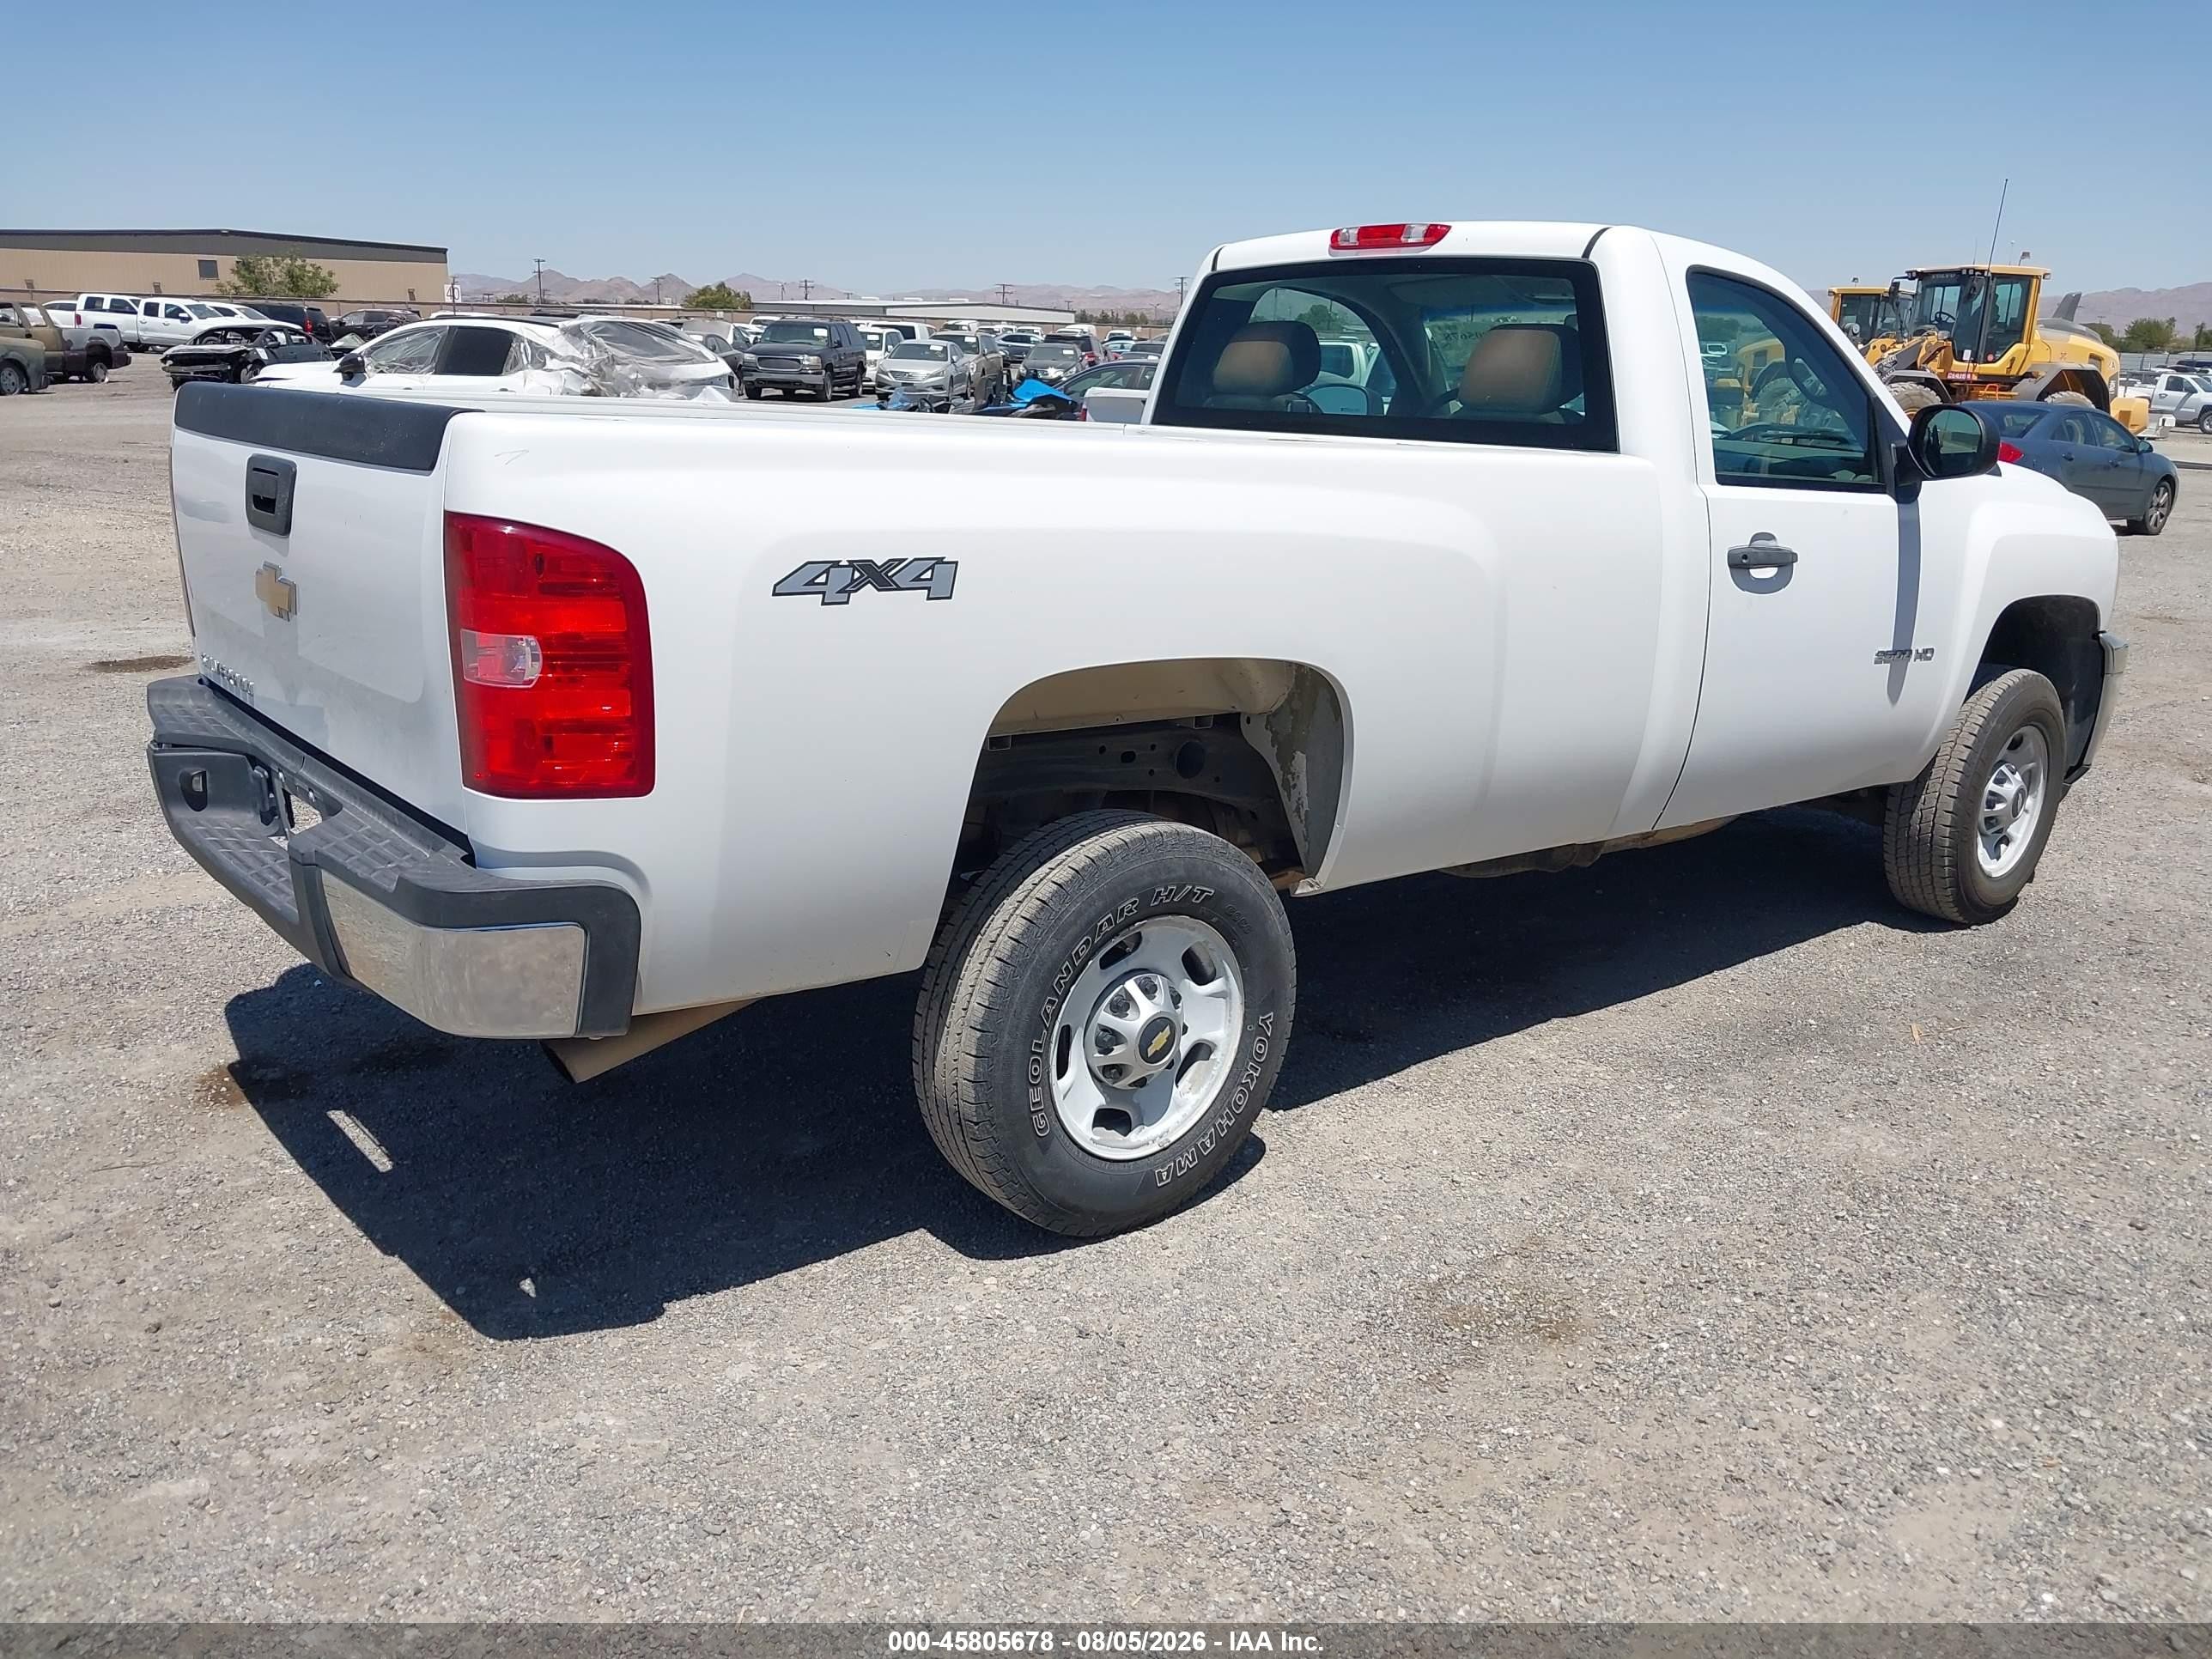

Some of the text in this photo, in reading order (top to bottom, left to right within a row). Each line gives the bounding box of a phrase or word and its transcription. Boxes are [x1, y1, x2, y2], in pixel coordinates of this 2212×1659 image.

[447, 287, 460, 301] 40
[1915, 648, 1935, 662] HD
[1029, 897, 1139, 1137] GEOLANDAR
[1150, 884, 1214, 907] H/T
[1155, 1012, 1273, 1188] YOKOHAMA
